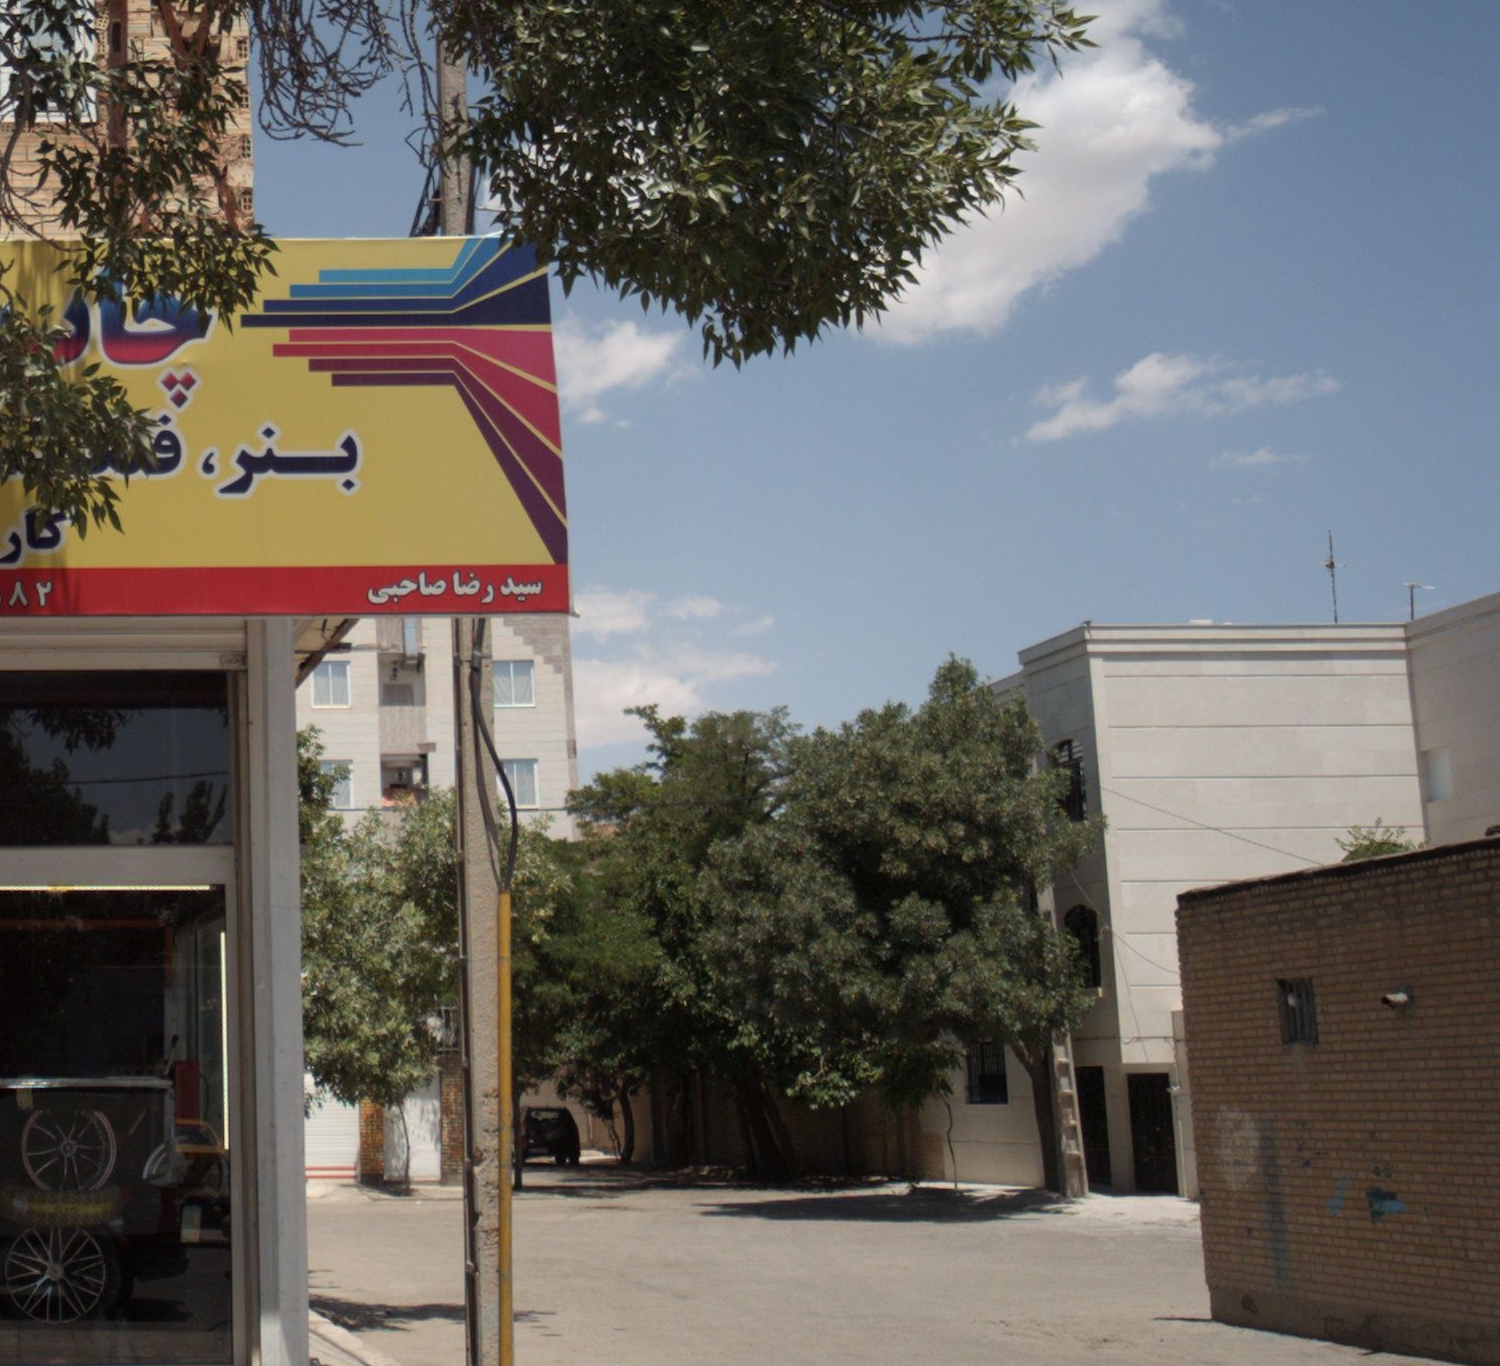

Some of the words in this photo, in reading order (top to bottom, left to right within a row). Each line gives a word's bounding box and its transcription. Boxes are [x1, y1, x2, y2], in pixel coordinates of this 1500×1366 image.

[367, 572, 448, 604] صاحبی
[452, 571, 494, 603] رضا
[500, 575, 542, 601] سید
